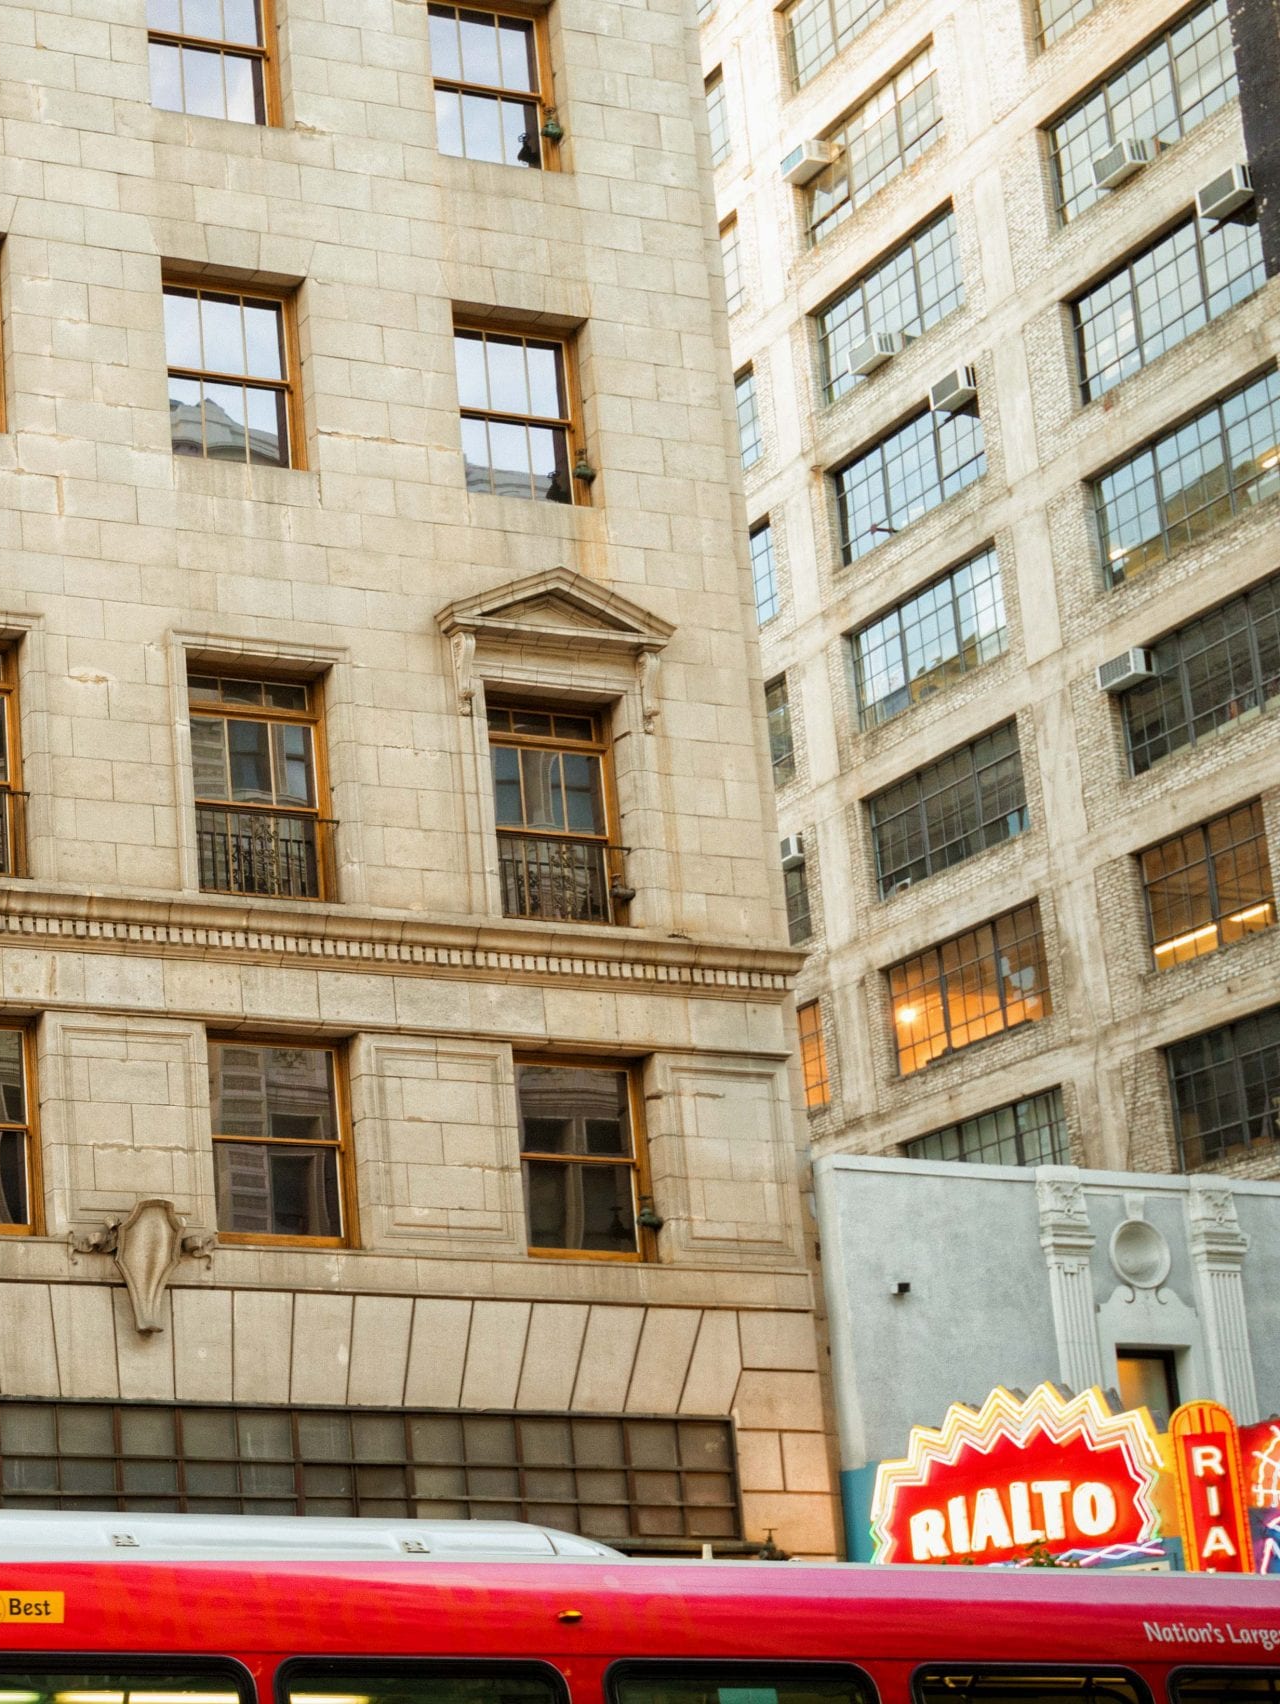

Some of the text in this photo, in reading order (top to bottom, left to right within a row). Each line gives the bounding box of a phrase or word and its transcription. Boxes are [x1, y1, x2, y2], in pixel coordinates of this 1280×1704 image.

[909, 1480, 1117, 1561] RIALTO
[1191, 1445, 1237, 1573] RIA
[9, 1598, 52, 1616] Best
[1142, 1620, 1280, 1651] Nation's Large
